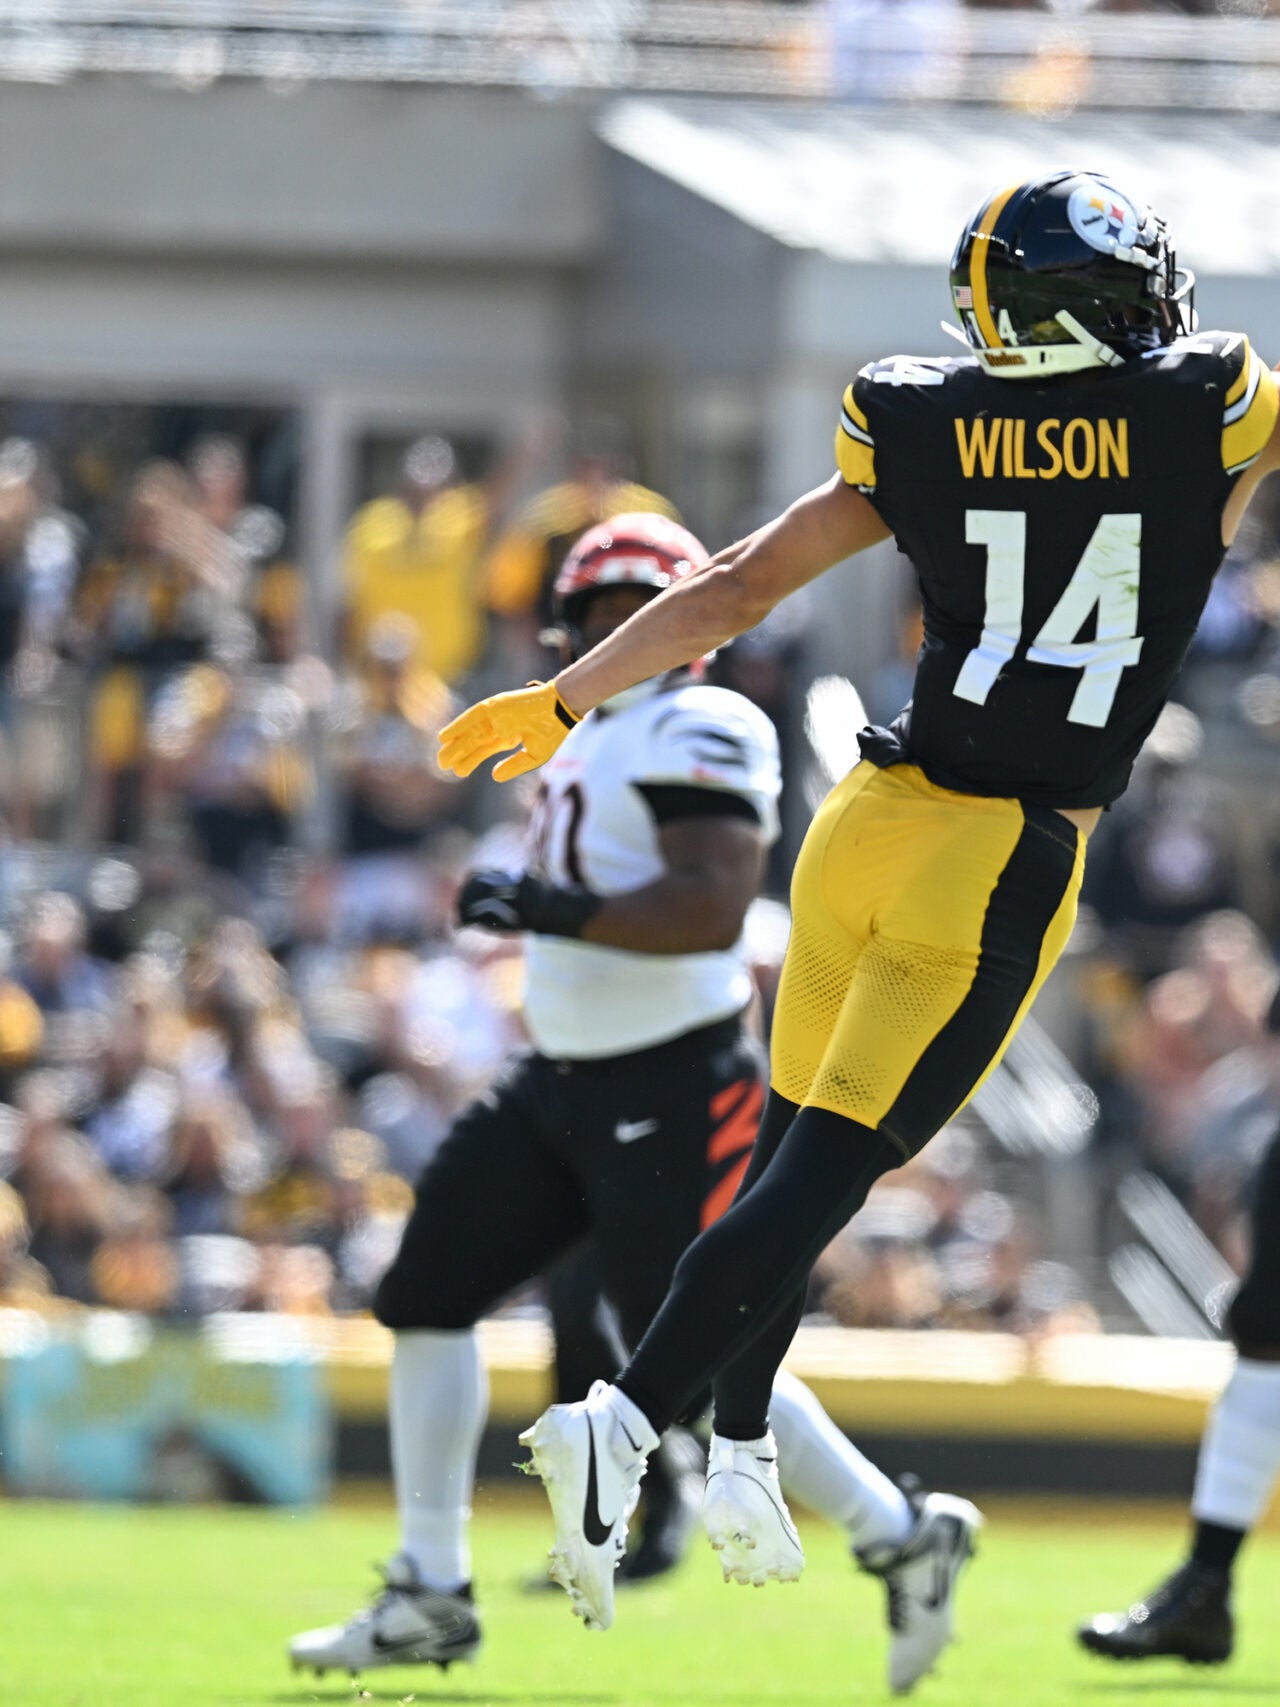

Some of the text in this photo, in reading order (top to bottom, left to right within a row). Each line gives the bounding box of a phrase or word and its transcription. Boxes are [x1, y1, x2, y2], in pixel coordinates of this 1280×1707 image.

[967, 309, 1019, 348] 14
[955, 418, 1129, 479] WILSON
[952, 510, 1144, 728] 14
